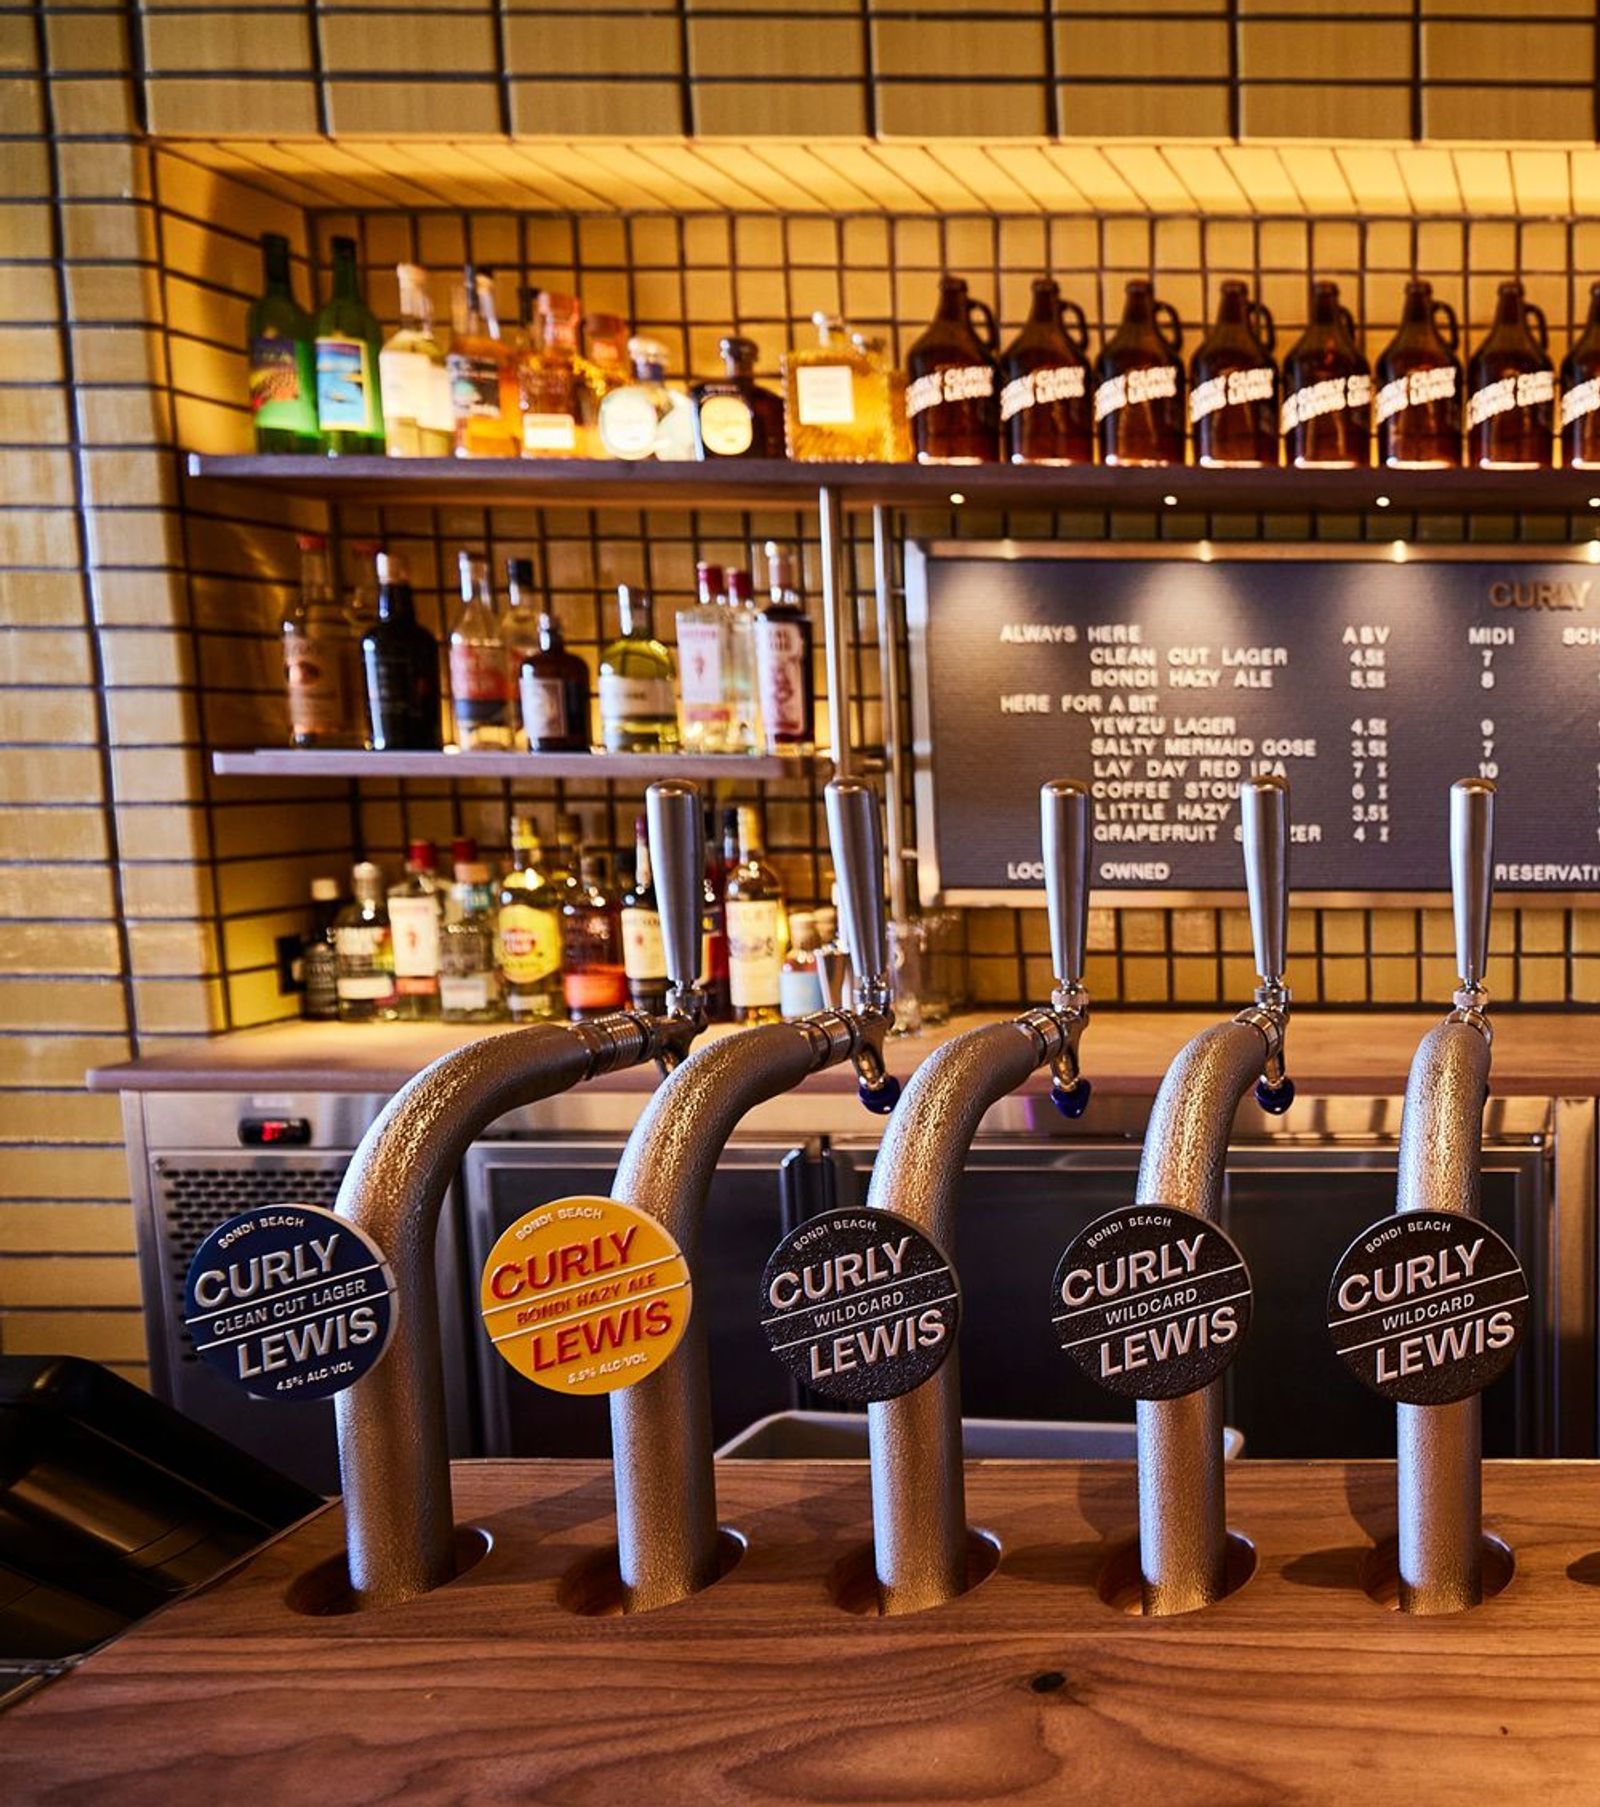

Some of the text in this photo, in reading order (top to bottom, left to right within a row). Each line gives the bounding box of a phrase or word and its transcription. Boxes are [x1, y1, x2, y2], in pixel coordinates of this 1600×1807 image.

[1488, 580, 1591, 609] CURLY
[1000, 625, 1077, 643] ALWAYS
[1088, 625, 1141, 643] HERE
[1468, 627, 1515, 645] MIDI
[1090, 648, 1157, 666] CLEAN
[1167, 648, 1208, 666] CUT
[1222, 648, 1288, 666] LAGER
[1482, 650, 1493, 668] 7
[1090, 670, 1158, 688] BONDI
[1169, 670, 1221, 688] HAZY
[1234, 670, 1273, 688] ALE
[1000, 695, 1158, 713] HERE FOR A BIT
[1090, 717, 1166, 735] YEWZU
[1174, 717, 1236, 735] LAGER
[1481, 718, 1494, 736] 9
[1090, 739, 1156, 757] SALTY
[1165, 739, 1254, 757] MERMAID
[1262, 739, 1317, 757] GOSE
[1482, 740, 1494, 758] 7
[1093, 760, 1134, 778] LAY
[1146, 760, 1188, 778] DAY
[1199, 760, 1241, 778] RED
[1251, 760, 1287, 778] IPA
[1353, 762, 1364, 779] 7
[1478, 762, 1499, 780] 10
[1091, 781, 1170, 799] COFFEE
[1184, 781, 1241, 799] STOU
[1096, 803, 1166, 821] LITTLE
[1177, 803, 1231, 821] HAZY
[1094, 824, 1217, 842] GRAPEFRUIT
[1353, 826, 1366, 843] 4
[1100, 862, 1171, 881] OWNED
[217, 1216, 304, 1250] BONDI BEACH
[515, 1208, 602, 1241] BONDI BEACH
[793, 1219, 878, 1251] BONDI BEACH
[1086, 1215, 1172, 1249] BONDI BEACH
[1365, 1221, 1451, 1254] BONDI BEACH
[193, 1234, 340, 1310] CURLY
[490, 1225, 637, 1300] CURLY
[769, 1236, 911, 1309] CURLY
[1061, 1233, 1205, 1307] CURLY
[1337, 1238, 1485, 1312] CURLY
[212, 1279, 367, 1337] CLEAN CUT LAGER
[516, 1272, 656, 1327] BONDI HAZY ALE
[814, 1291, 904, 1328] WILDCARD
[1105, 1288, 1198, 1325] WILDCARD
[1382, 1294, 1474, 1331] WILDCARD
[236, 1306, 378, 1380] LEWIS
[531, 1299, 672, 1372] LEWIS
[810, 1308, 946, 1380] LEWIS
[1100, 1306, 1238, 1378] LEWIS
[1375, 1311, 1515, 1384] LEWIS
